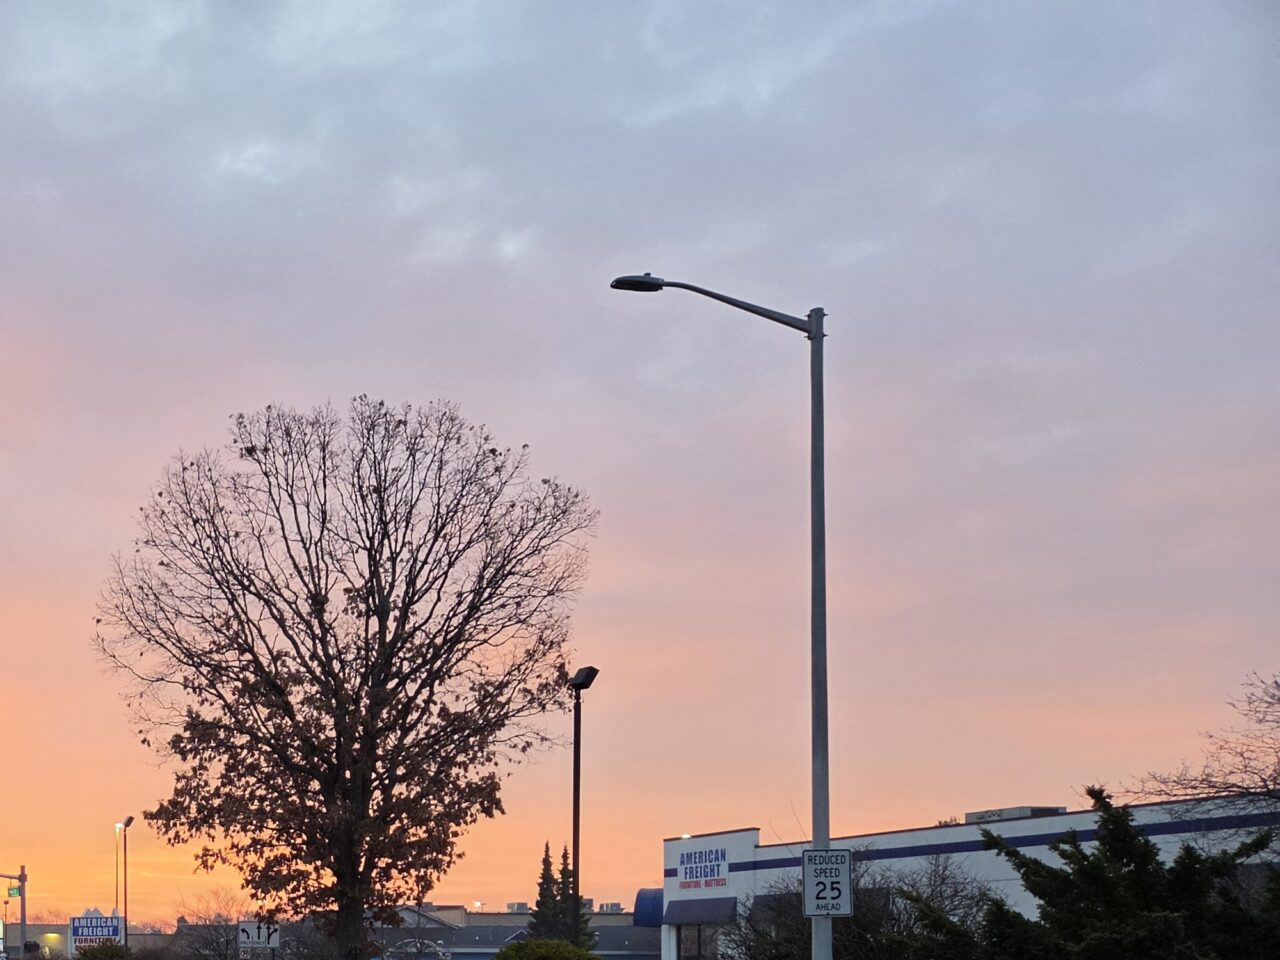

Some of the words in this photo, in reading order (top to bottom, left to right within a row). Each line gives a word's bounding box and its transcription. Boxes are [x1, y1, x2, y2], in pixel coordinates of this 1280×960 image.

[680, 848, 726, 866] AMERICAN
[807, 854, 847, 866] REDUCED
[684, 863, 721, 880] FREIGHT
[813, 867, 841, 878] SPEED
[815, 880, 842, 901] 25
[815, 902, 841, 911] AHEAD
[74, 917, 117, 927] AMERICAN
[78, 927, 113, 936] FREIGHT
